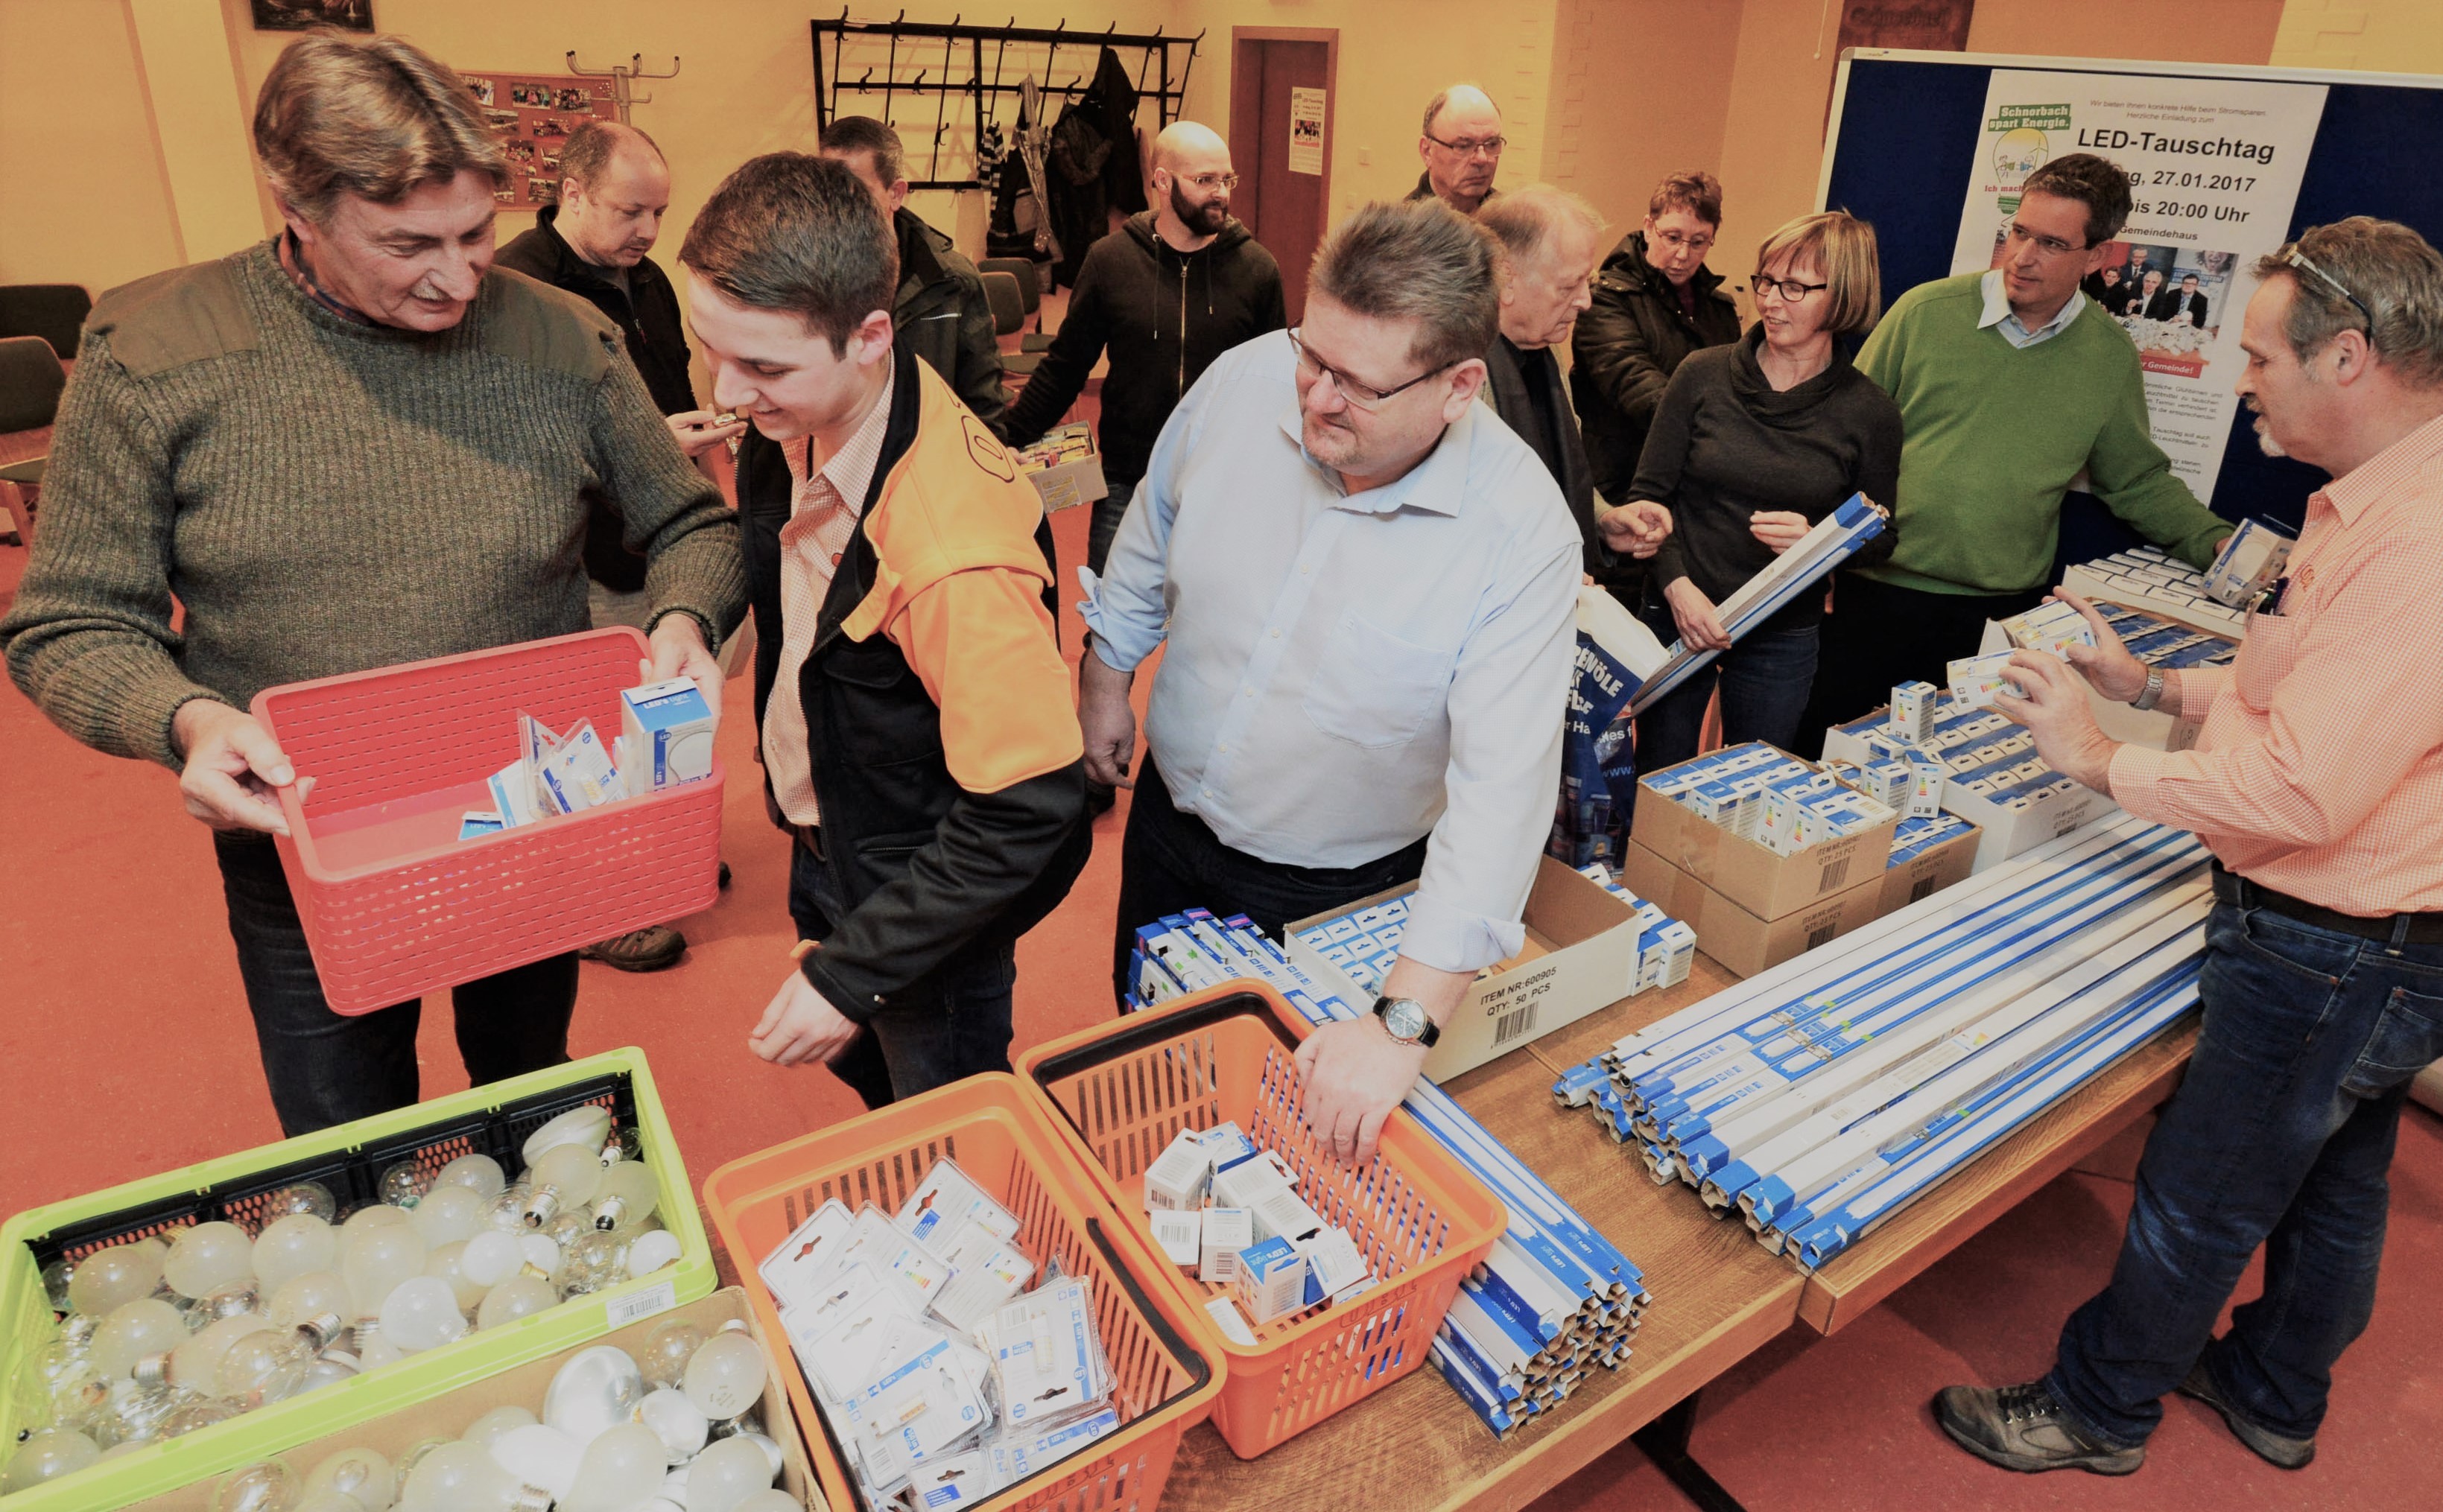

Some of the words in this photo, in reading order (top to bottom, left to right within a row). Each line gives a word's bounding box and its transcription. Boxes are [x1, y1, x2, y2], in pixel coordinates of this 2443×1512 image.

[2001, 106, 2068, 117] Schnorbach
[1989, 119, 2018, 130] spart
[2022, 118, 2069, 130] Energie.
[2077, 127, 2275, 165] LED-Tauschtag
[2152, 170, 2257, 192] 27.01.2017
[2155, 200, 2208, 218] 20:00
[2214, 206, 2250, 223] Uhr
[2120, 226, 2198, 241] Gemeindehaus
[2148, 361, 2194, 374] Gemeinde!
[1480, 988, 1506, 1006] ITEM
[1507, 966, 1557, 995] NR:600905
[1487, 1001, 1510, 1016] QTY:
[1515, 993, 1527, 1005] 50
[1531, 982, 1551, 997] PCS
[1267, 1245, 1288, 1259] LED's
